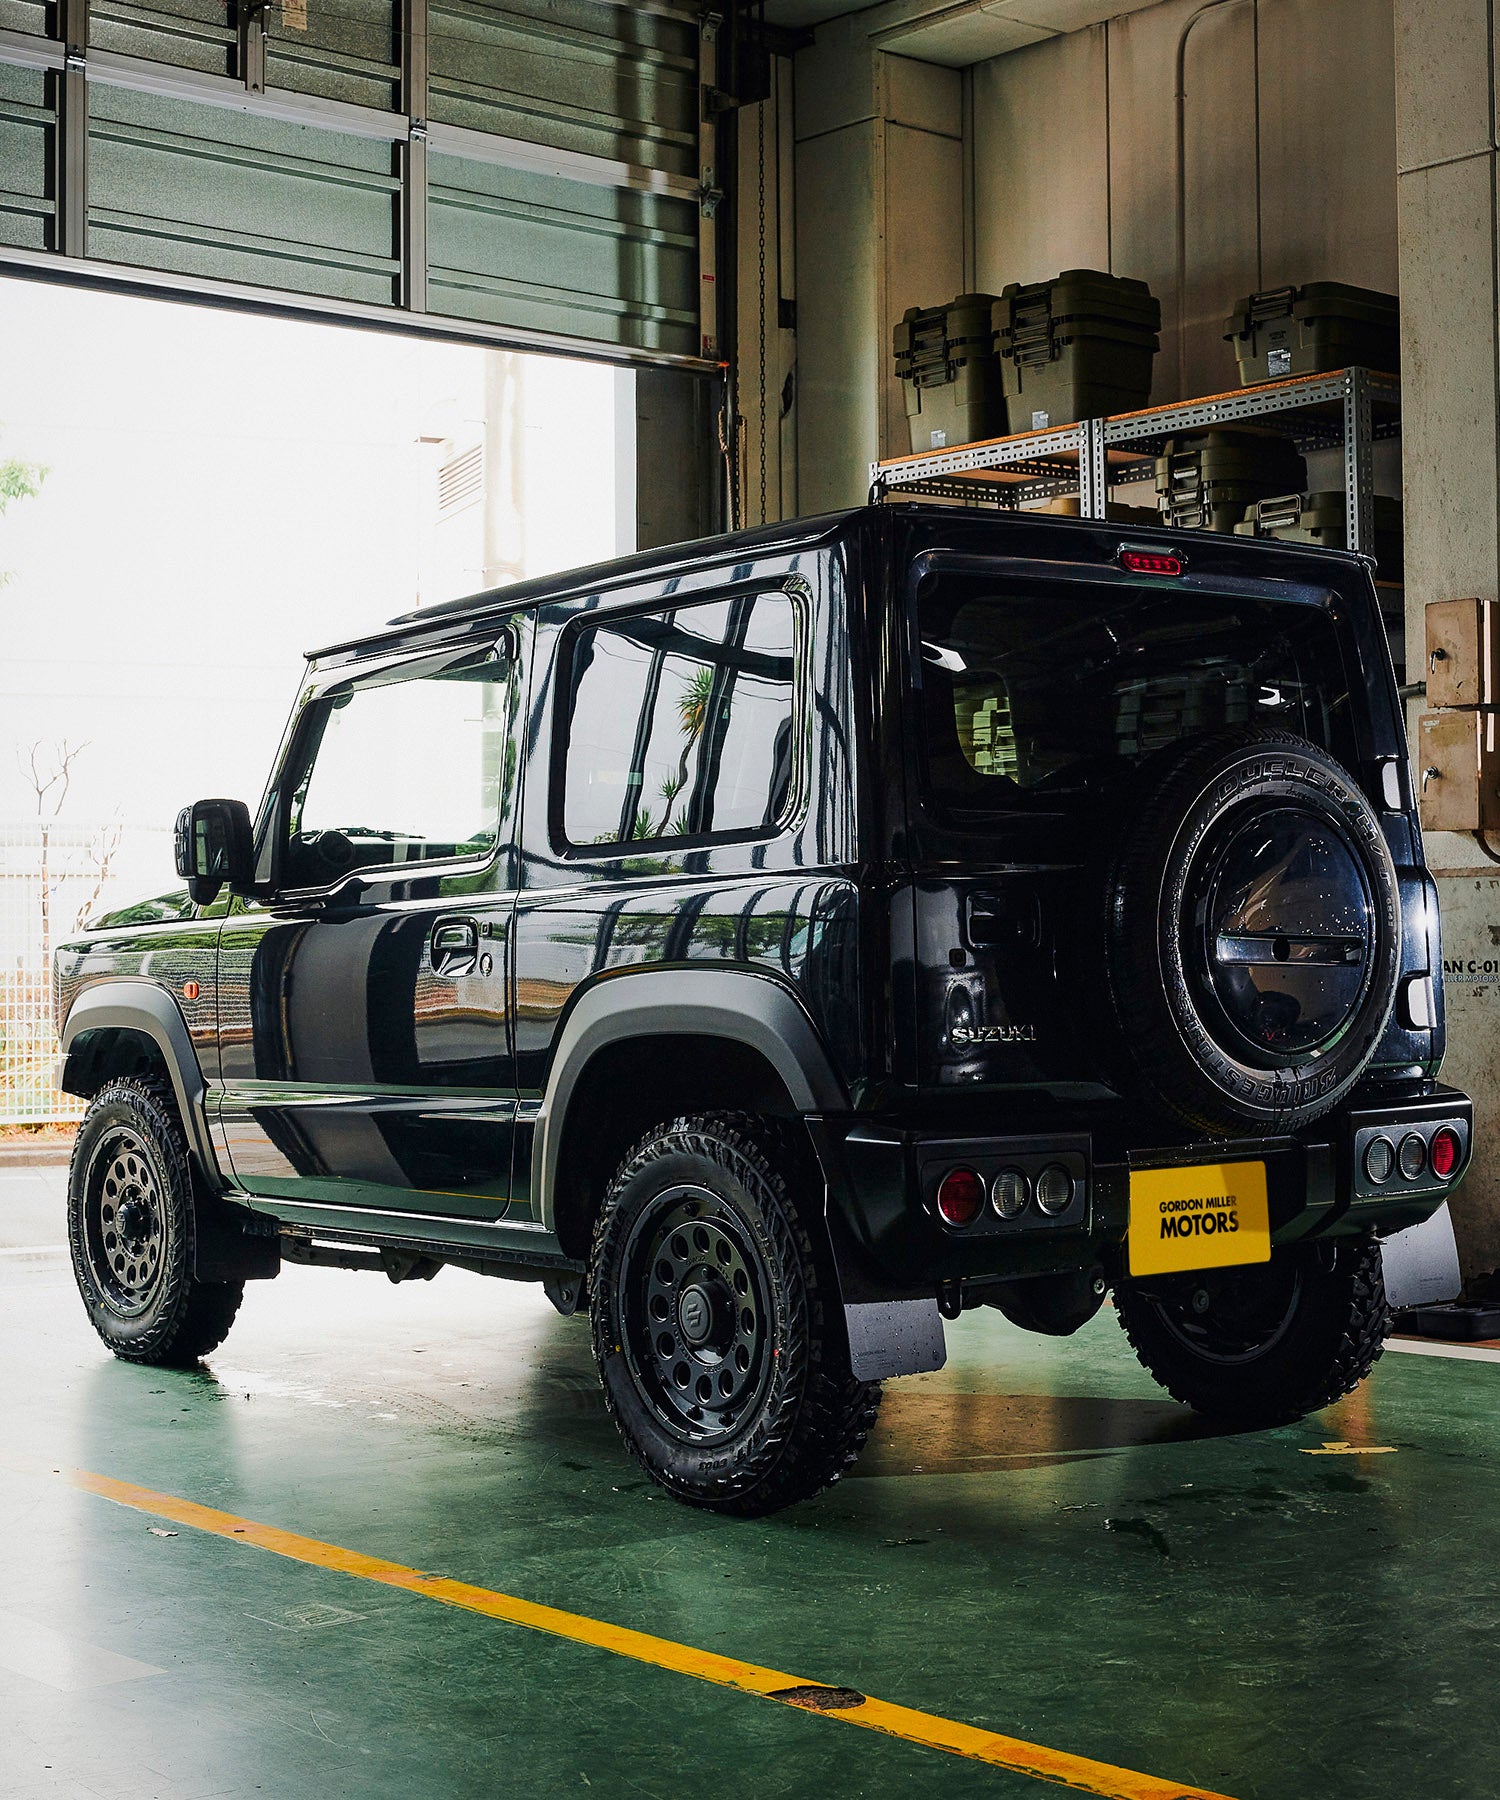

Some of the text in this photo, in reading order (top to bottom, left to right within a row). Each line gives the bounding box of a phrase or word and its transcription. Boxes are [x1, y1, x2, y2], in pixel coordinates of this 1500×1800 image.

[1218, 760, 1348, 802] DUELER
[1468, 960, 1498, 973] C-01
[951, 1024, 1037, 1043] SUZUKI
[1159, 1195, 1237, 1213] GORDON MILLER
[1160, 1211, 1239, 1239] MOTORS
